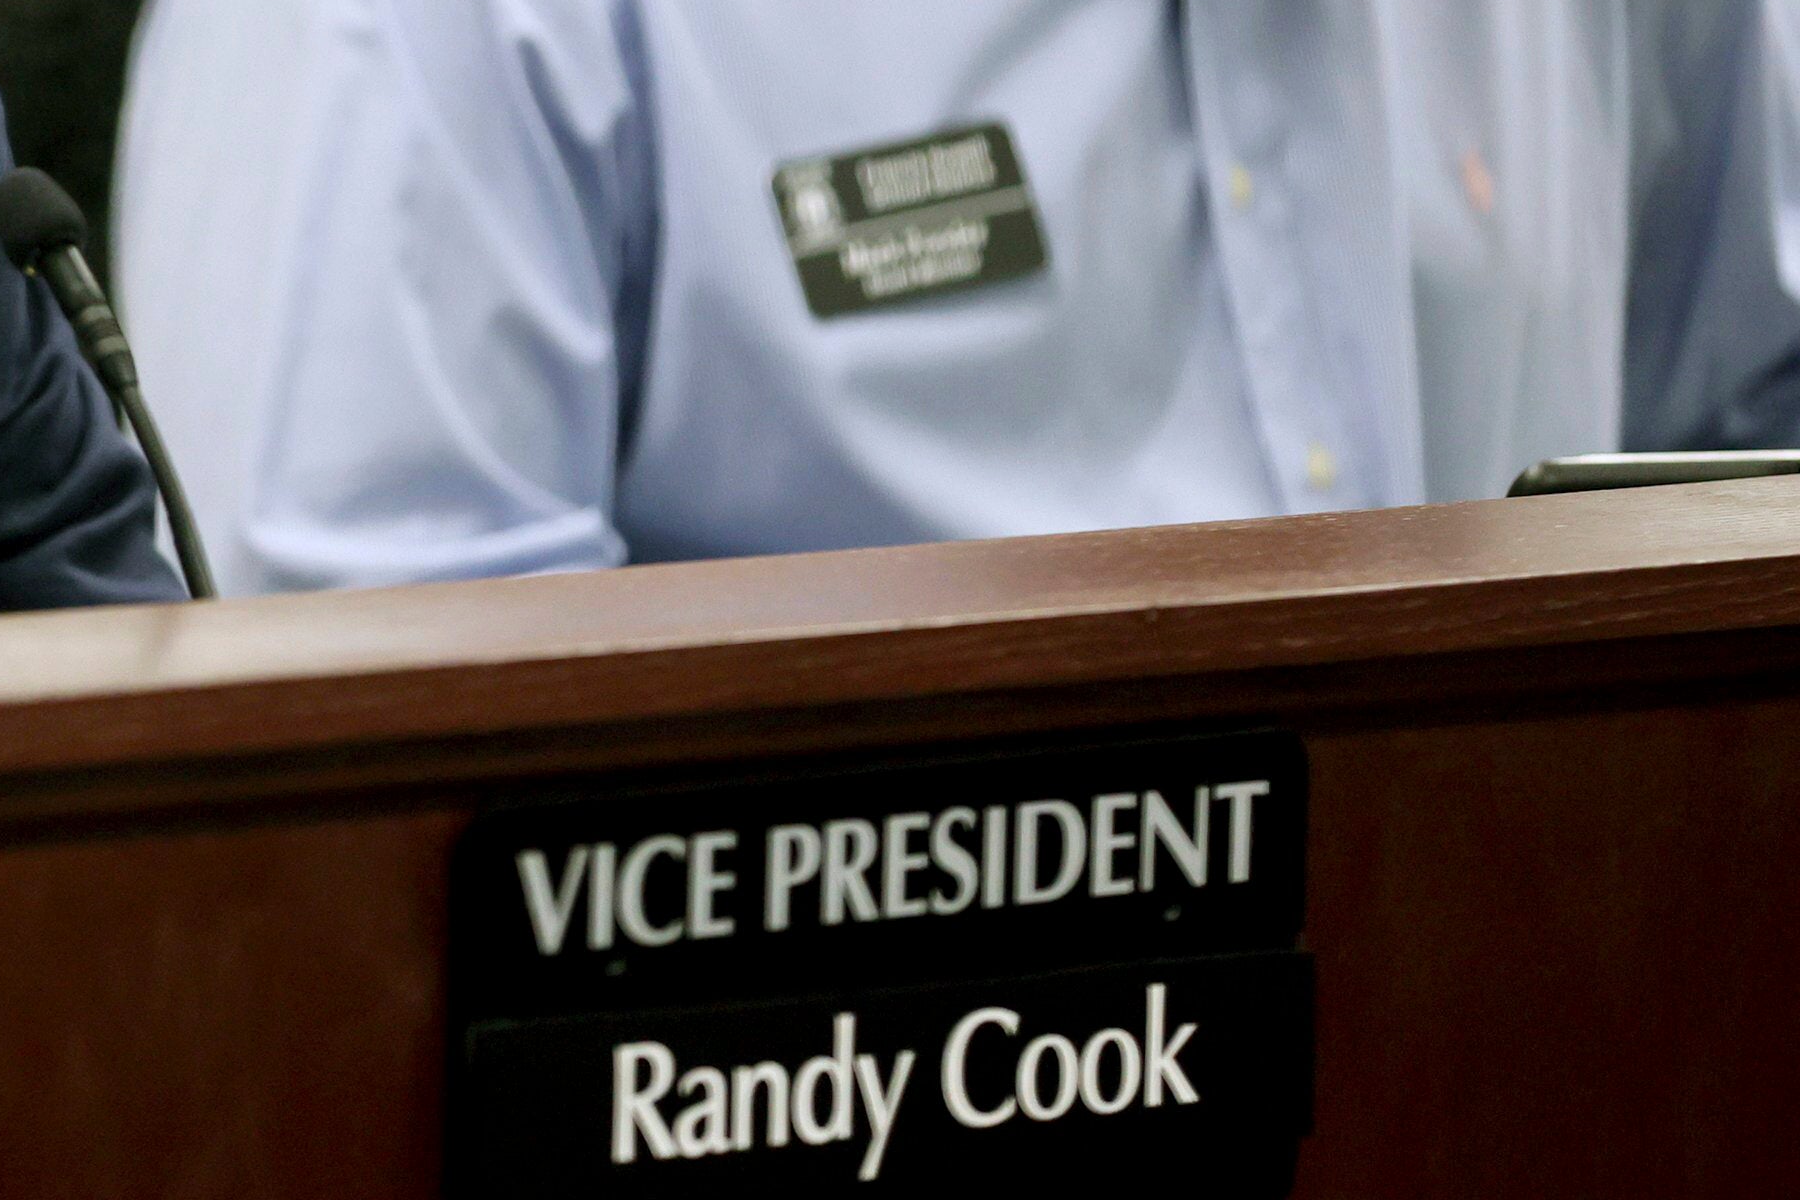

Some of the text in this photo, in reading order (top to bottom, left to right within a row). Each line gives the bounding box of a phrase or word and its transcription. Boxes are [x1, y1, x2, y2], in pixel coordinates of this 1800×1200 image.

[517, 780, 1270, 955] VICE PRESIDENT
[611, 983, 1199, 1181] Randy Cook
